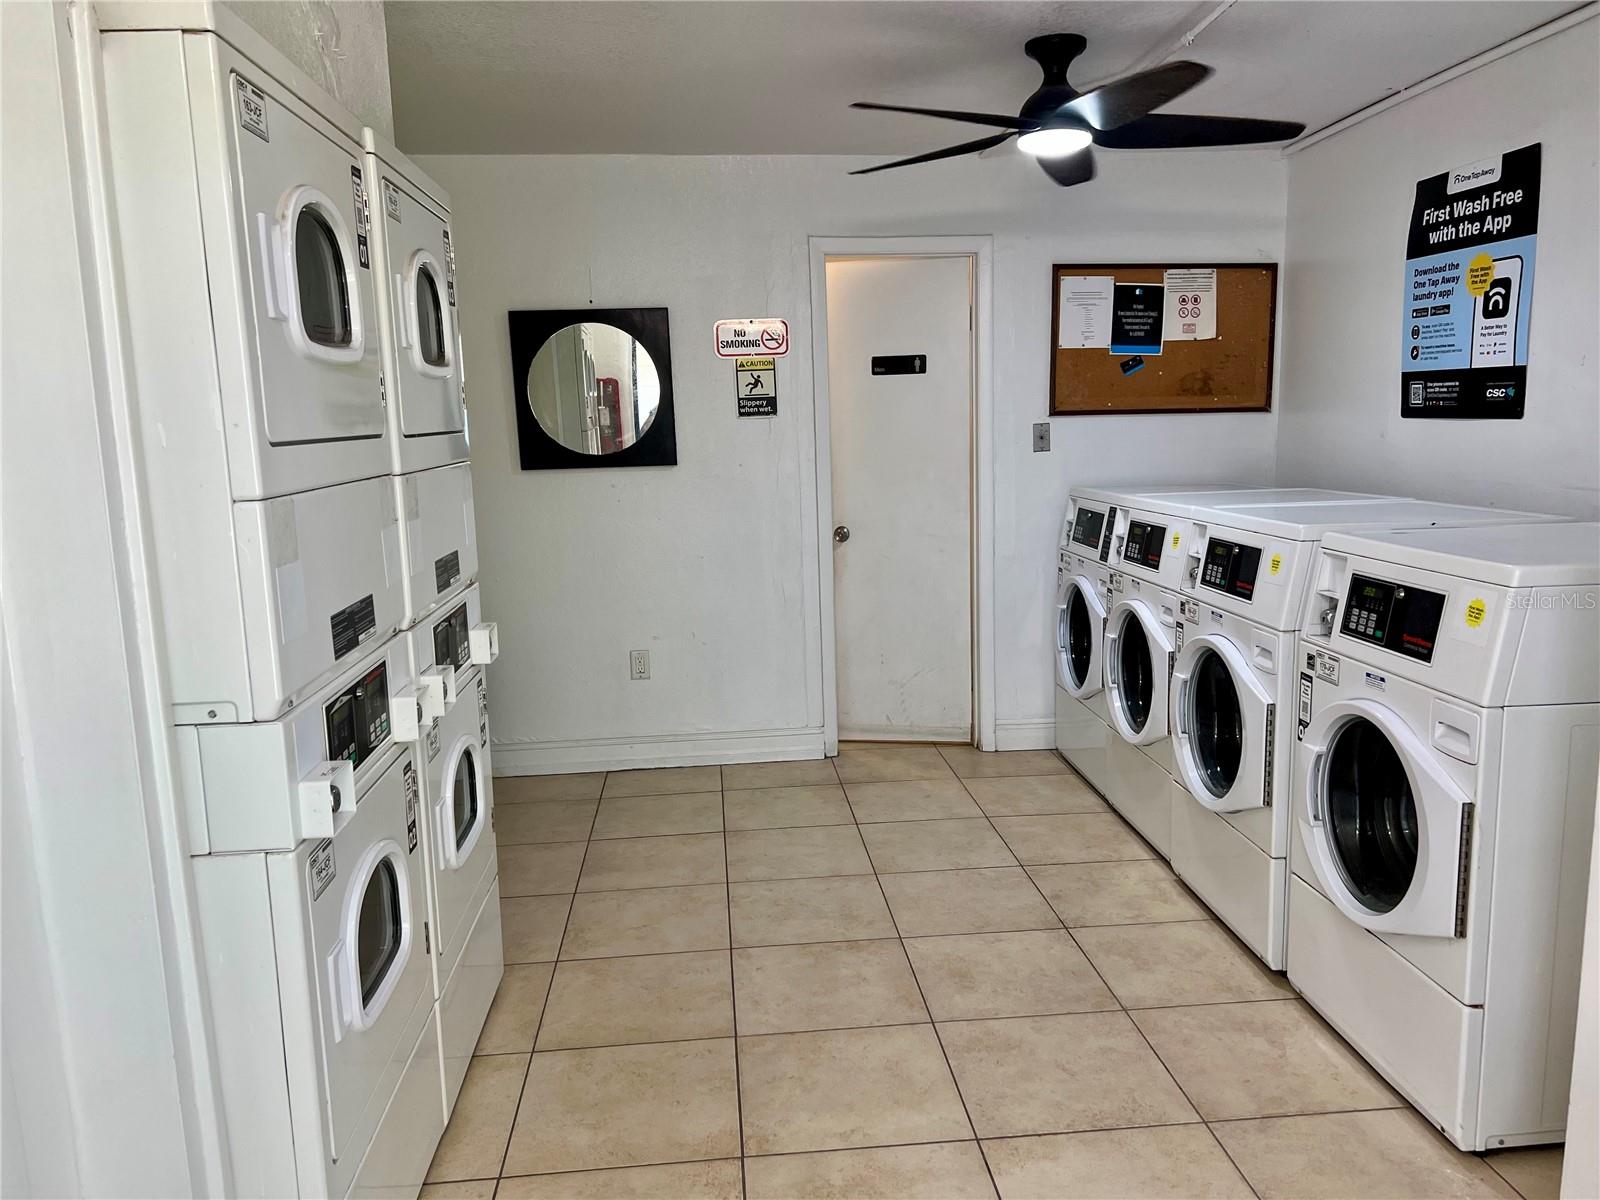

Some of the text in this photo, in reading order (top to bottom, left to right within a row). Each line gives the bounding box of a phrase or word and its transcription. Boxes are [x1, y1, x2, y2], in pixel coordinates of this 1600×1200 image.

[1422, 189, 1523, 226] First Wash Free
[1429, 214, 1512, 244] with the App
[1414, 262, 1460, 278] Download the
[1413, 275, 1460, 290] One Tap Away
[1412, 287, 1454, 302] laundry app!
[734, 328, 746, 338] NO
[720, 339, 760, 348] SMOKING
[1486, 388, 1506, 397] CSC
